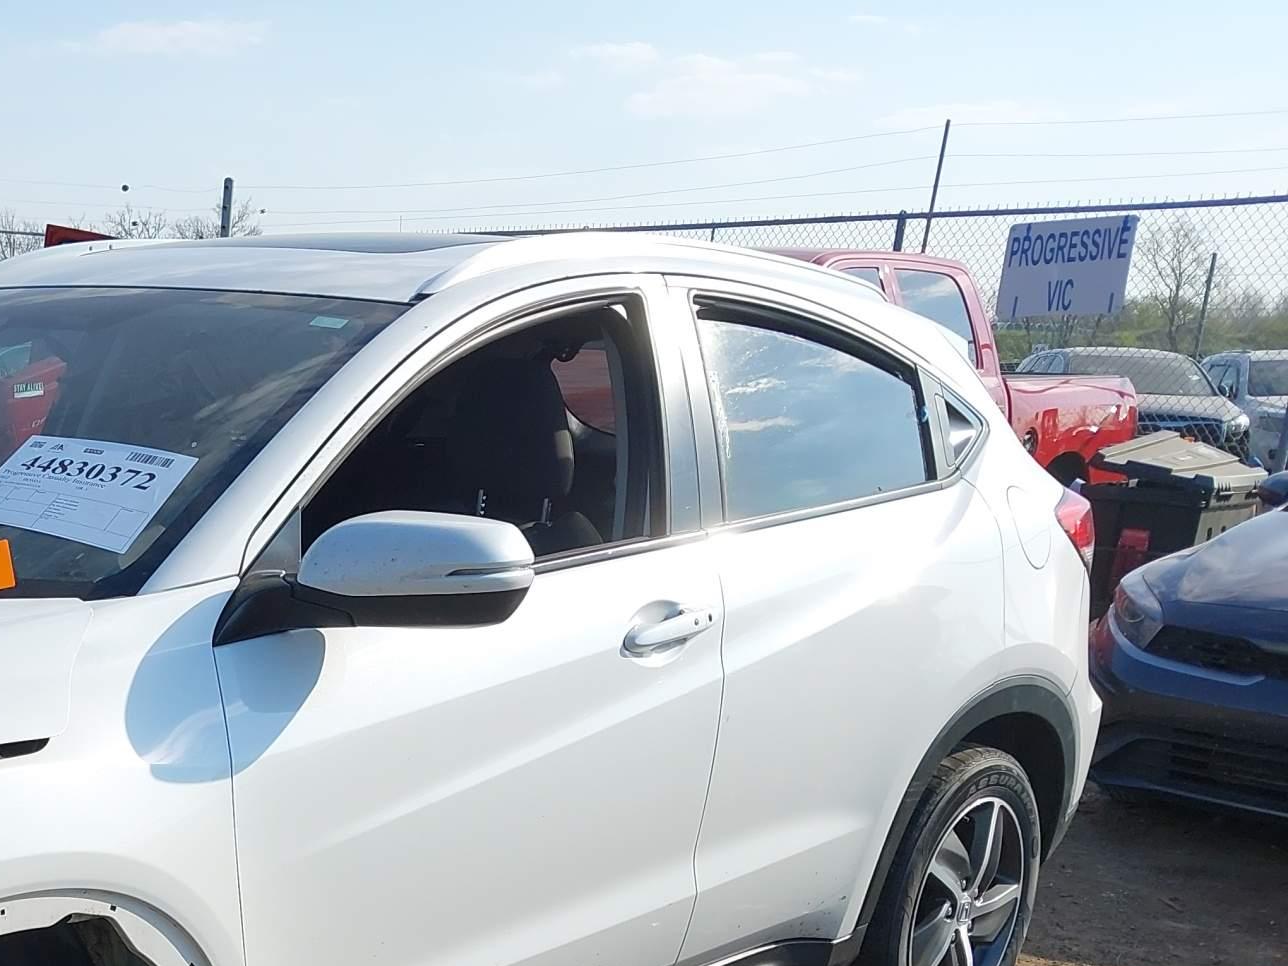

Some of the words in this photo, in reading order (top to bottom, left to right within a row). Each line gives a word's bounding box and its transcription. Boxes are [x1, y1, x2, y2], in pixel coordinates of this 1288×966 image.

[1008, 226, 1132, 268] PROGRESSIVE
[1047, 279, 1074, 312] VIC
[20, 454, 158, 492] 44830372
